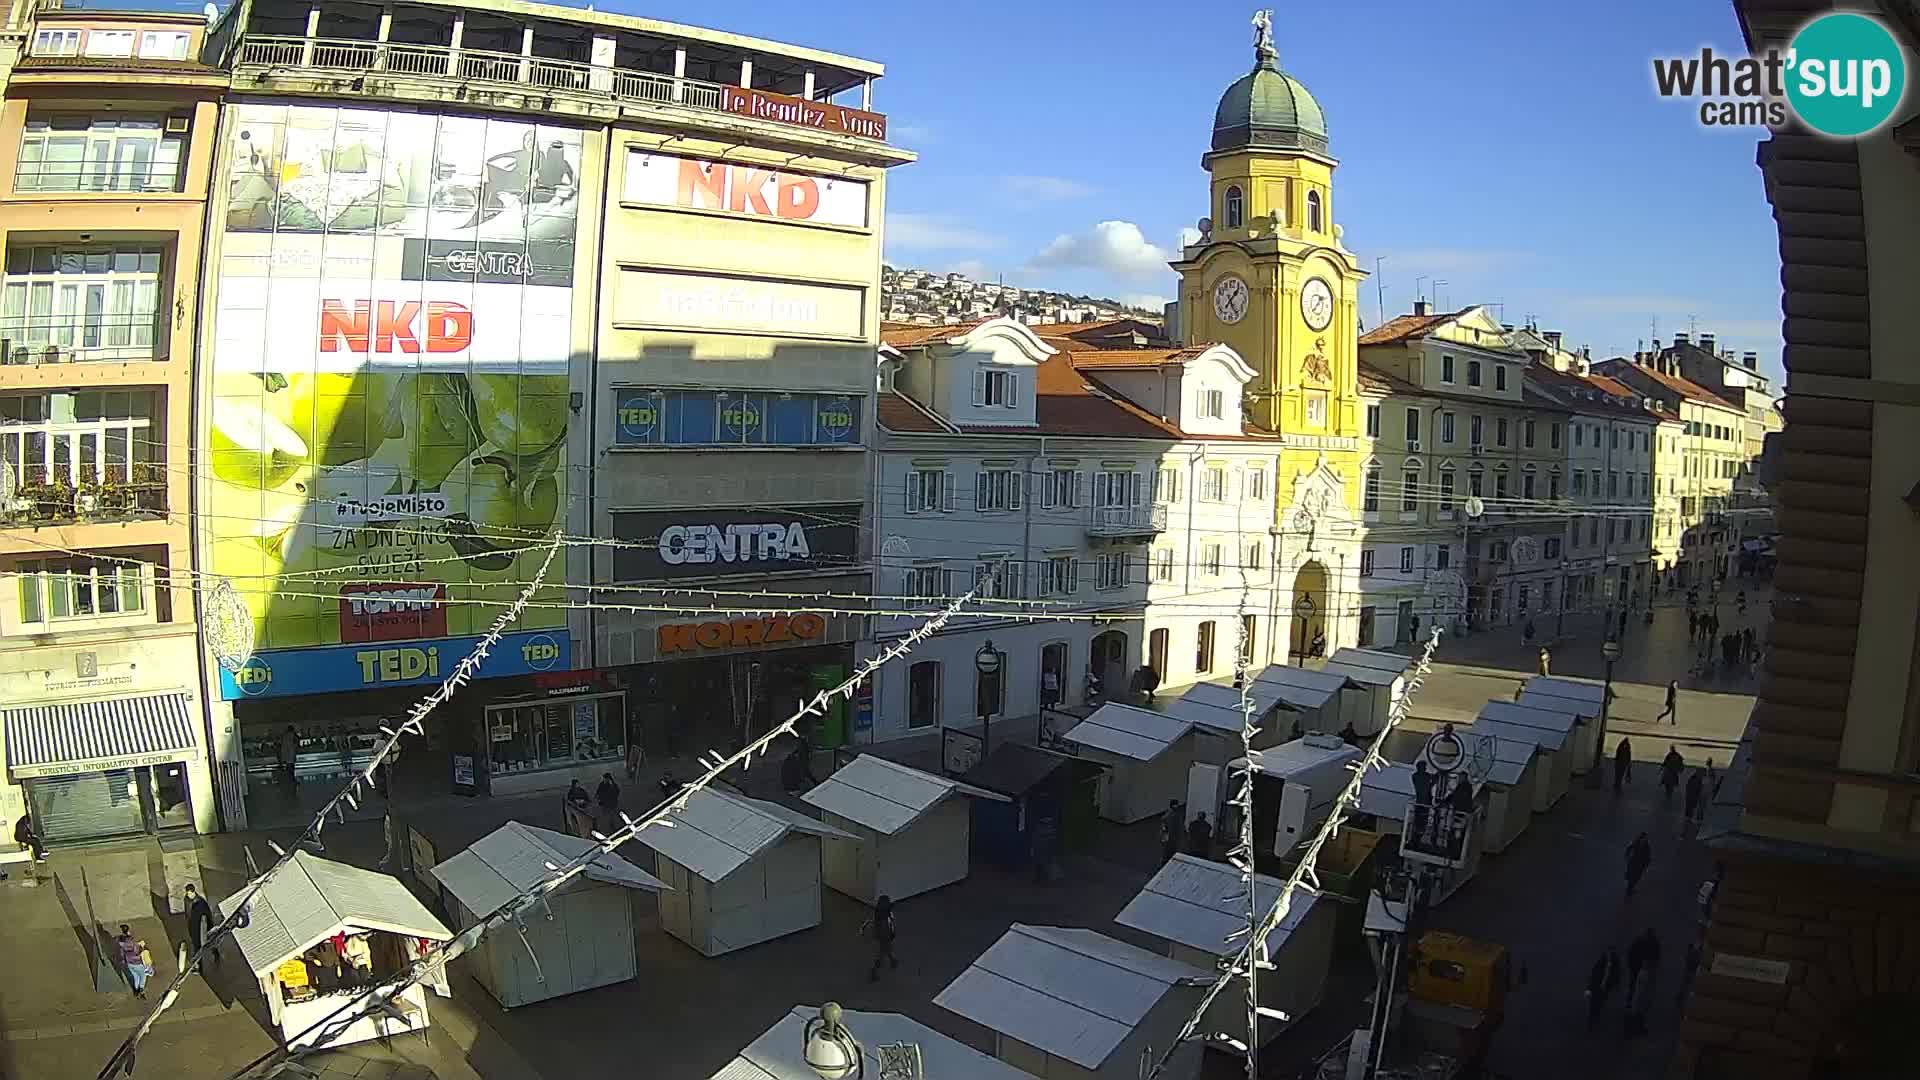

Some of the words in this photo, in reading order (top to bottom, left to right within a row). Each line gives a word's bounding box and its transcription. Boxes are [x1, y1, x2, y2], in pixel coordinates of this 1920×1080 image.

[676, 159, 821, 219] NKD
[448, 249, 534, 276] CENTRA
[320, 297, 474, 353] NKD
[619, 408, 657, 426] TEDi
[723, 409, 760, 426] TEDi
[820, 411, 854, 427] TEDi
[336, 497, 445, 516] #TvojeMisto
[333, 529, 357, 550] ZA
[366, 525, 450, 548] DNEVNO
[658, 521, 811, 565] CENTRA
[358, 548, 425, 576] SVJEŽE
[659, 613, 826, 652] KORZO
[356, 646, 440, 684] TEDi
[522, 643, 560, 661] TEDi
[142, 754, 173, 765] CENTAR
